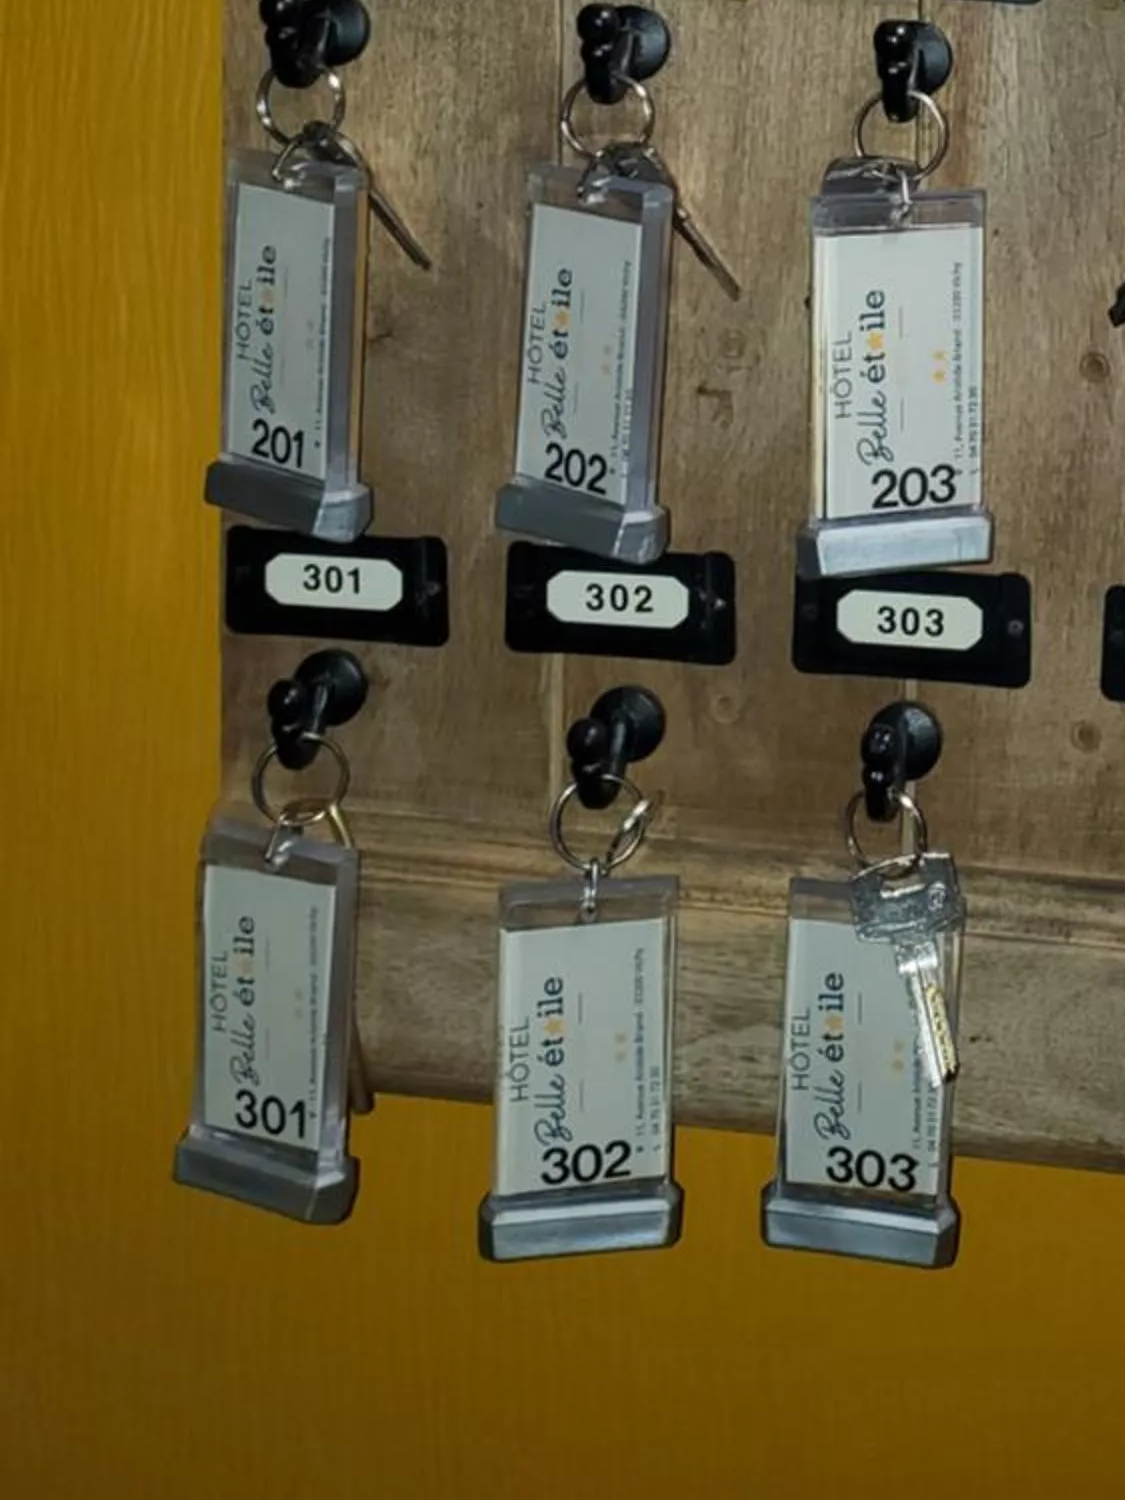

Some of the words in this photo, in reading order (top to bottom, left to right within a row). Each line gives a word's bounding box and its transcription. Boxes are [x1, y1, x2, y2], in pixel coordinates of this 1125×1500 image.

[255, 245, 276, 335] étile
[548, 268, 572, 359] étile
[860, 290, 885, 383] étile
[251, 343, 276, 414] Belle
[541, 367, 567, 440] Belle
[252, 419, 304, 468] 201
[857, 390, 894, 466] Belle
[545, 443, 607, 494] 202
[872, 464, 956, 509] 203
[304, 564, 359, 594] 301
[586, 584, 653, 612] 302
[878, 606, 943, 636] 303
[233, 915, 255, 1006] étile
[230, 1015, 260, 1086] Belle
[537, 976, 564, 1067] étile
[818, 972, 844, 1063] étile
[236, 1089, 306, 1139] 301
[534, 1074, 573, 1147] Belle
[814, 1069, 850, 1140] Belle
[540, 1140, 631, 1185] 302
[826, 1146, 919, 1192] 303
